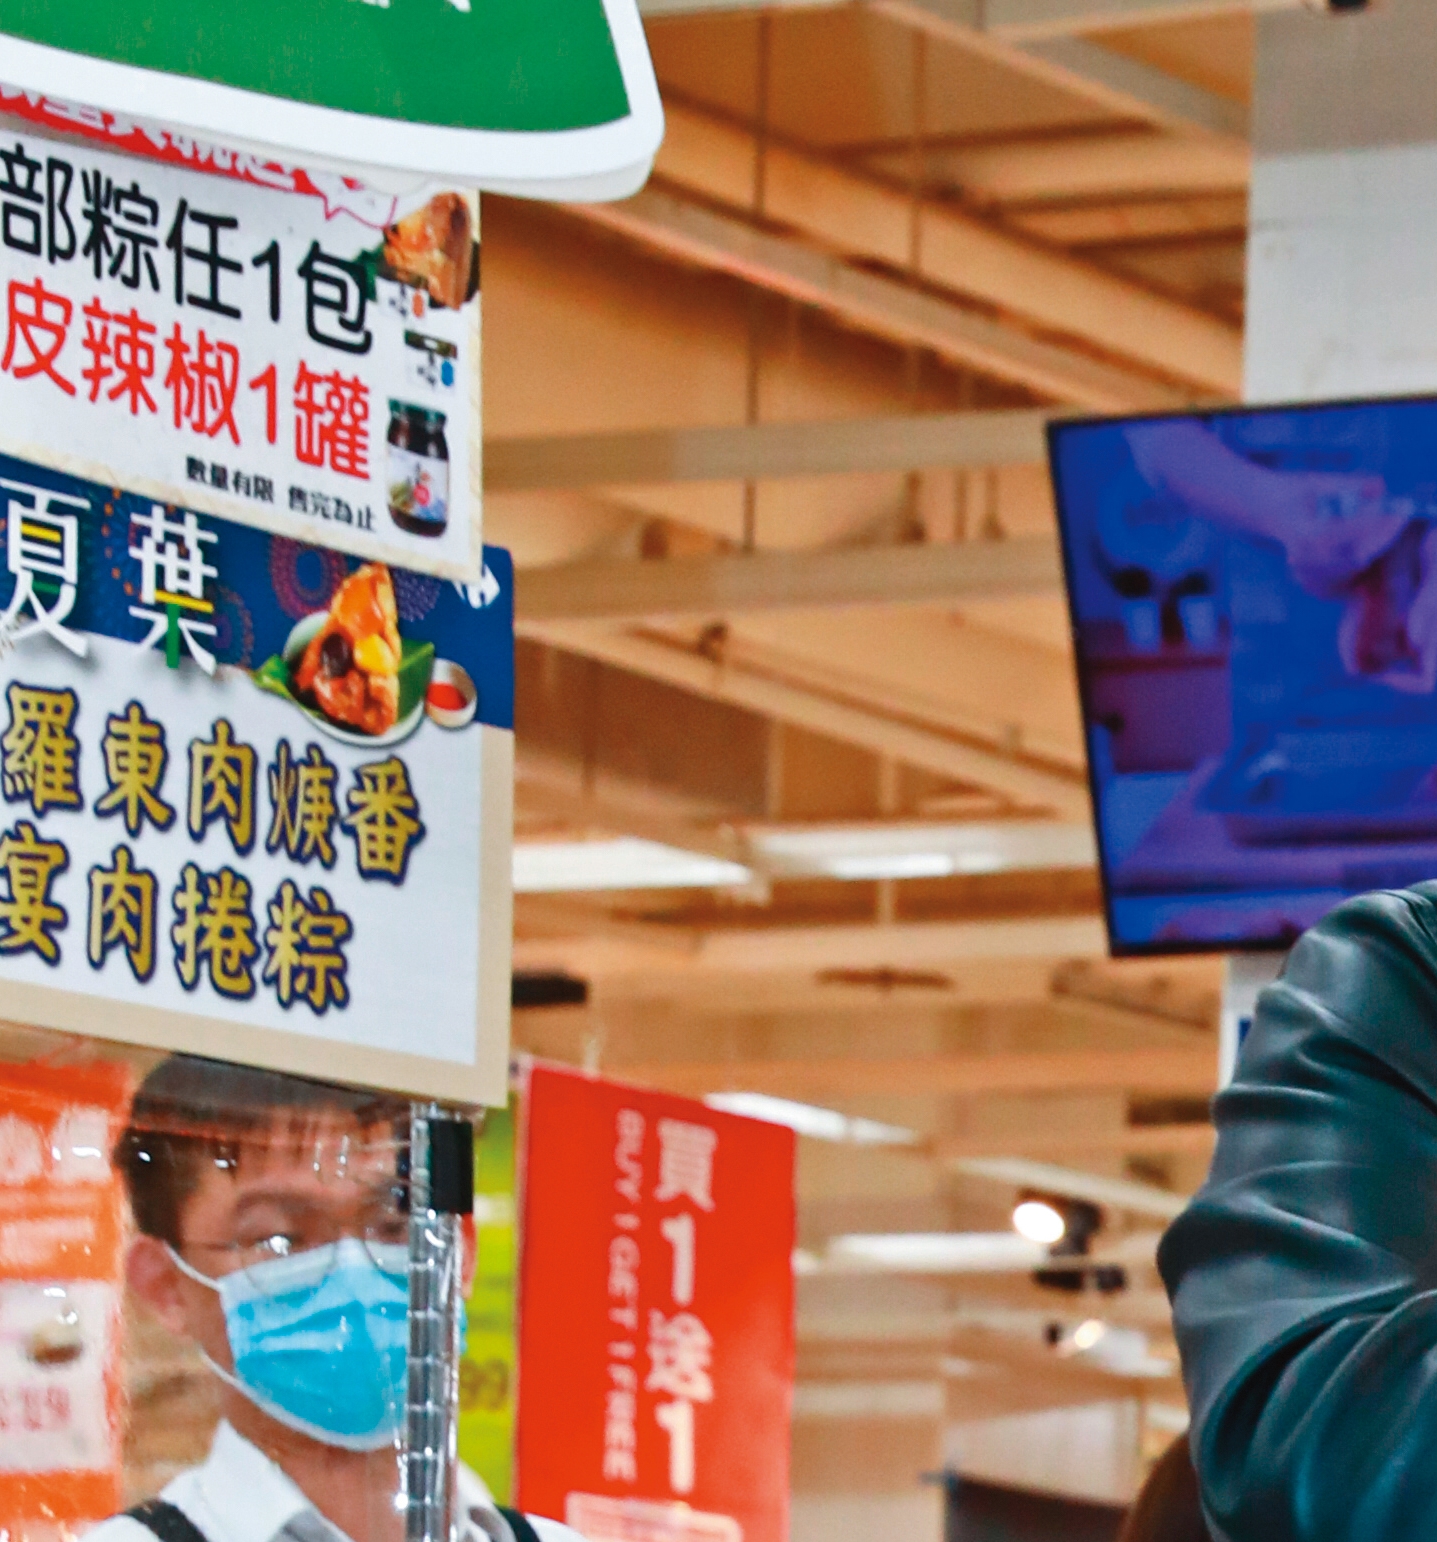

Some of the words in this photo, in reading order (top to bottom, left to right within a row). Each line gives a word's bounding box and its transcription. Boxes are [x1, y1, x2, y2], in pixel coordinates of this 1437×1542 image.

[0, 143, 373, 355] 部粽任1包
[1, 276, 373, 483] 皮辣椒1罐
[186, 455, 274, 503] 數量有限
[288, 485, 375, 532] 售完為止
[2, 681, 426, 887] 羅東肉焿番
[0, 821, 354, 1015] 宴肉捲粽
[645, 1116, 719, 1494] 買1送1
